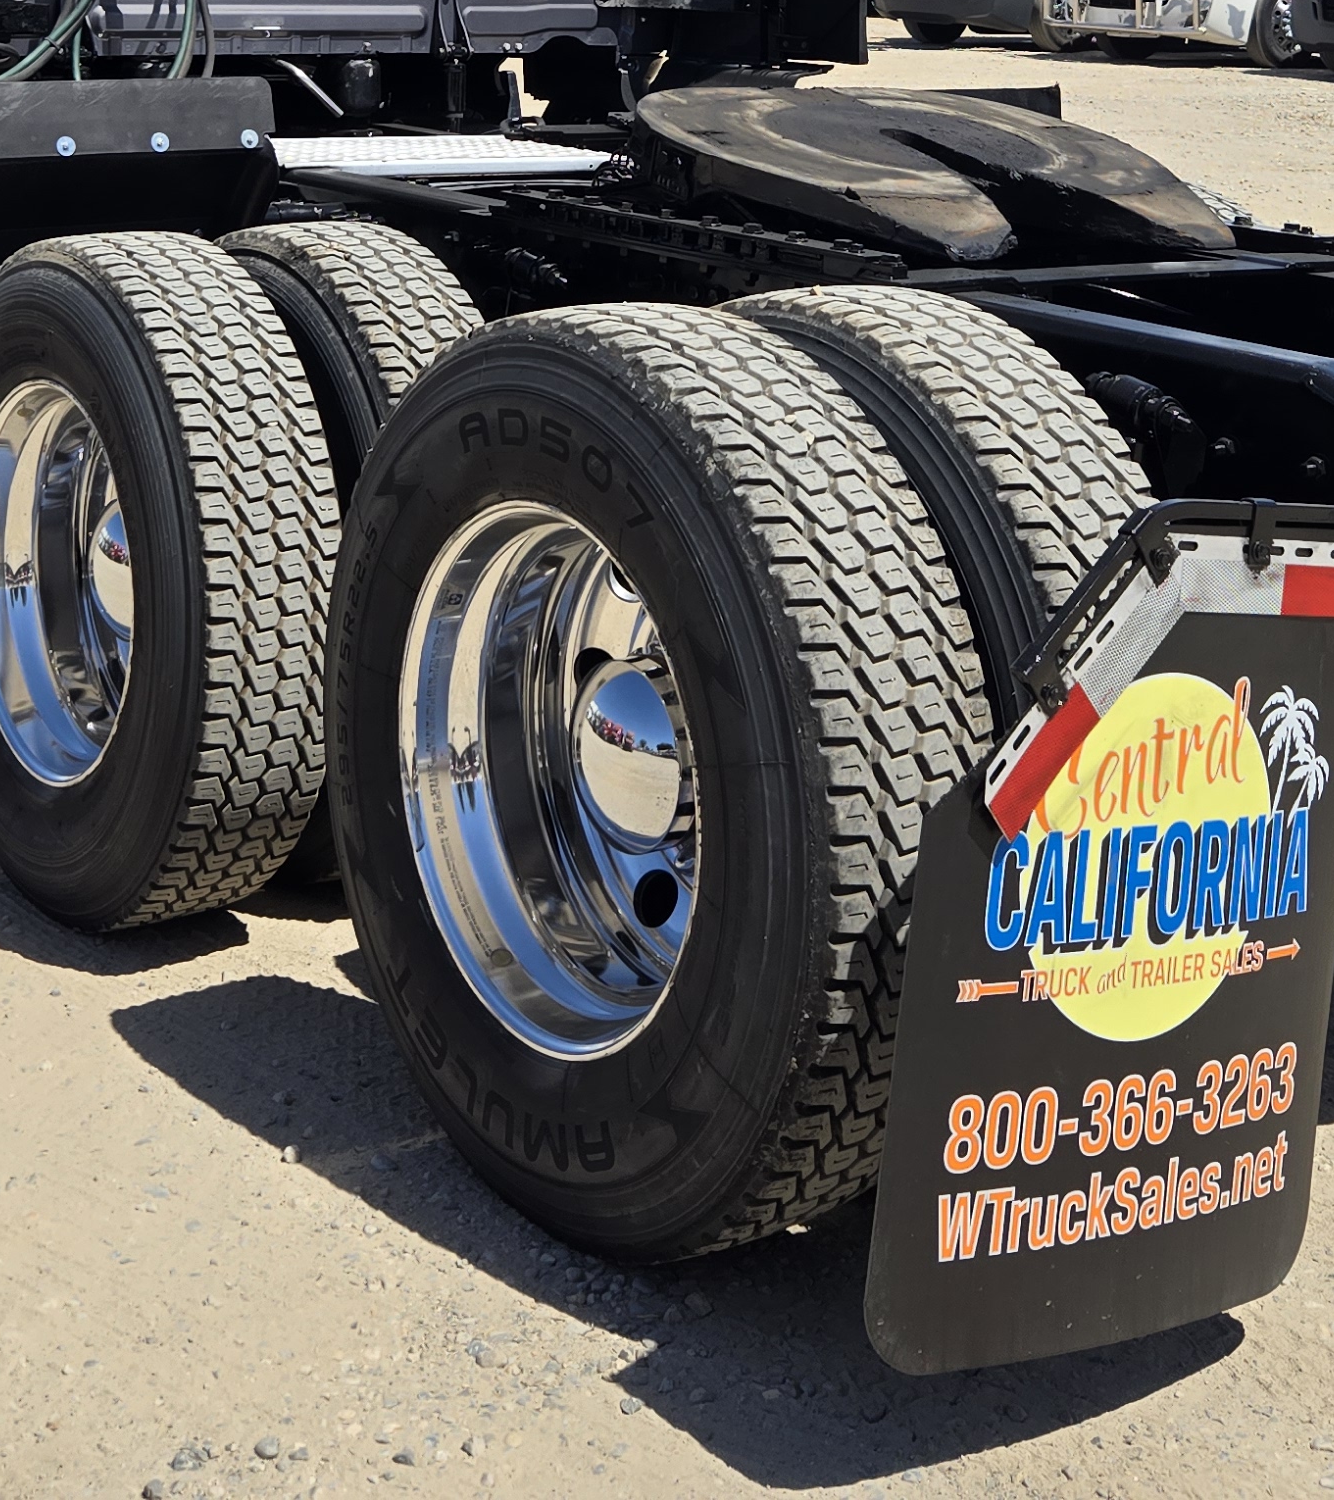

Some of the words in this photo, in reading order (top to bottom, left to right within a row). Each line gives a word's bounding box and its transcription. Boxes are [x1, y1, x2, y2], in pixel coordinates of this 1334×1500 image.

[458, 407, 655, 532] AD507
[336, 520, 380, 807] 295/75R22.5
[1035, 676, 1251, 840] Central
[985, 805, 1310, 954] CALIFORNIA
[1021, 967, 1091, 1002] TRUCK
[1096, 951, 1129, 995] and
[1131, 952, 1205, 989] TRAILER
[1210, 940, 1265, 979] SALES
[383, 963, 618, 1174] AMULET
[943, 1041, 1299, 1176] 800-366-3263
[936, 1141, 1290, 1264] WTruckSales.net
